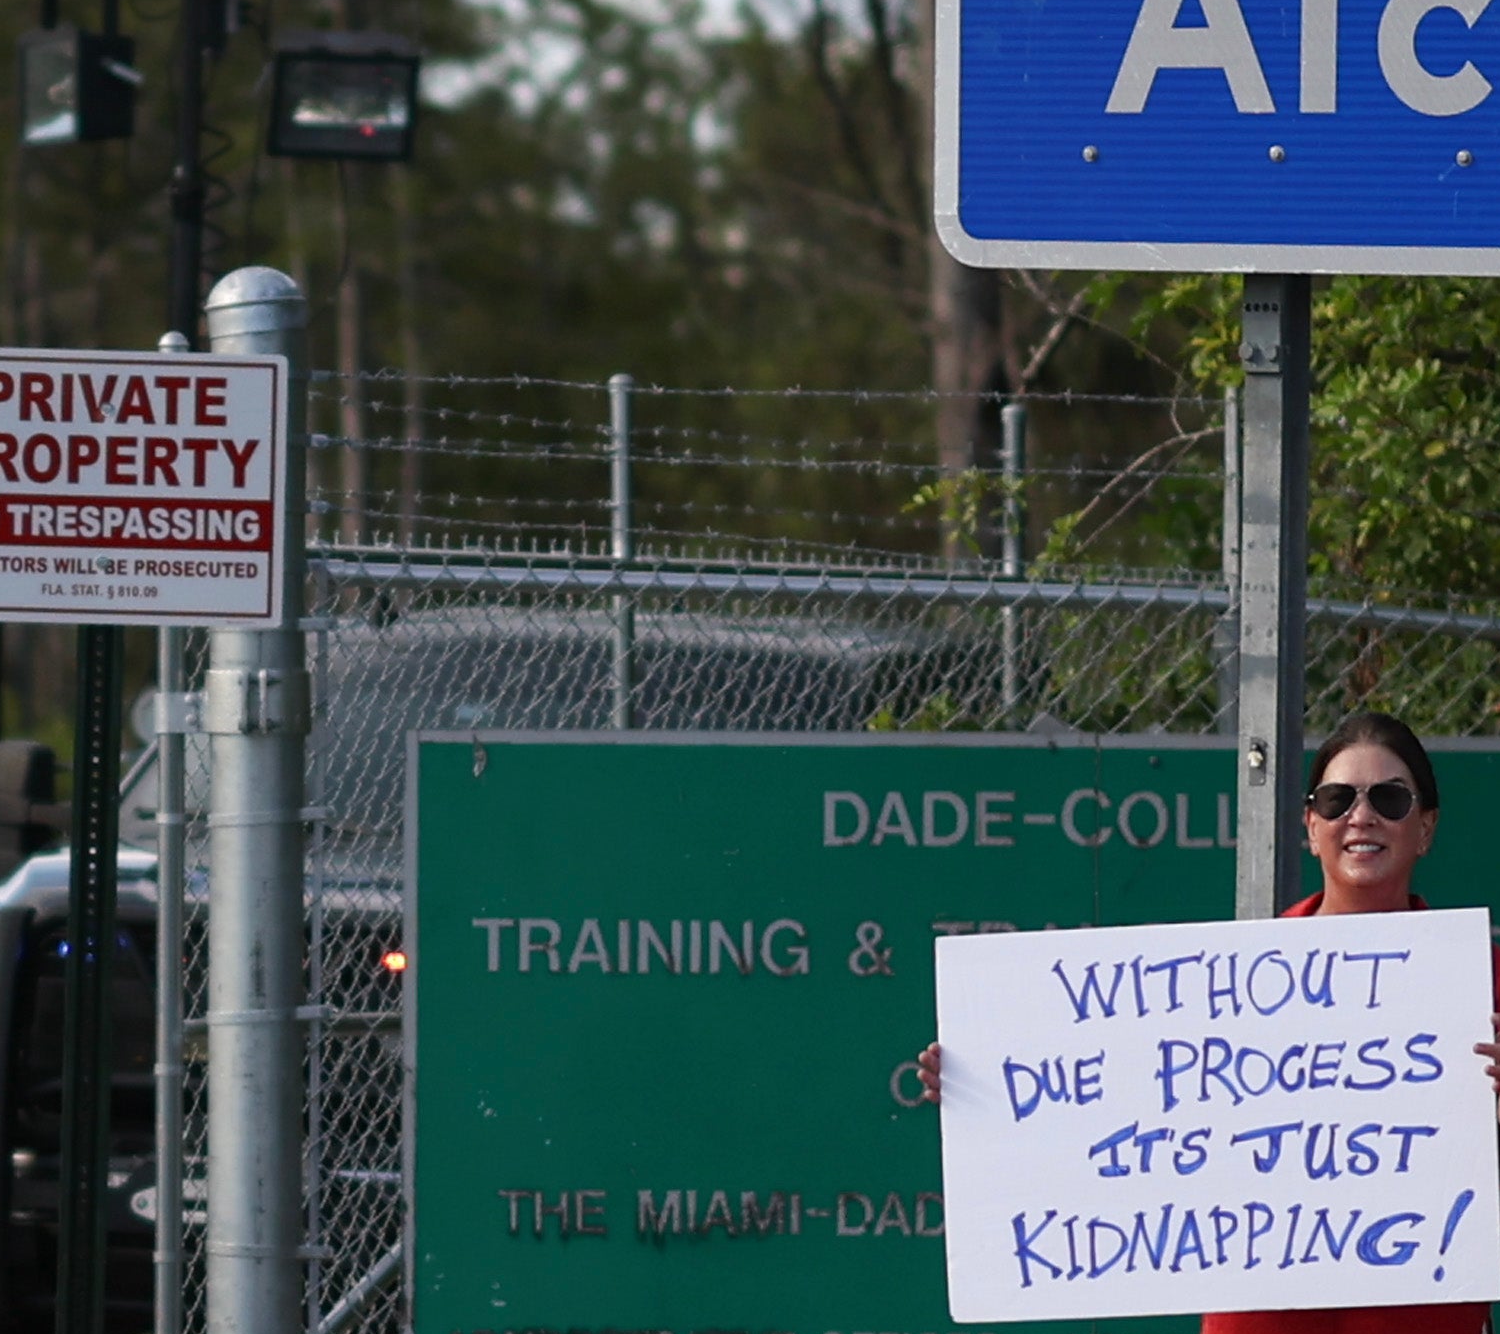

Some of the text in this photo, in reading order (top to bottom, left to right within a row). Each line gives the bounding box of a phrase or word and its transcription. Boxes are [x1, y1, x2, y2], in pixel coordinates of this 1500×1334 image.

[6, 503, 262, 543] TRESPASSING
[41, 583, 65, 597] FLA.
[118, 585, 159, 598] 810.09
[53, 557, 98, 576] WILL
[133, 559, 259, 579] PROSECUTED
[821, 788, 1240, 847] DADE-COLL
[472, 917, 896, 978] TRAINING &
[1051, 948, 1411, 1024] WITHOUT
[1001, 1049, 1106, 1122] DUE
[1154, 1033, 1444, 1114] PROCESS
[1089, 1120, 1440, 1180] IT'S JUST
[499, 1188, 945, 1239] THE MIAMI-DAD
[1011, 1189, 1476, 1288] KIDNAPPING!
